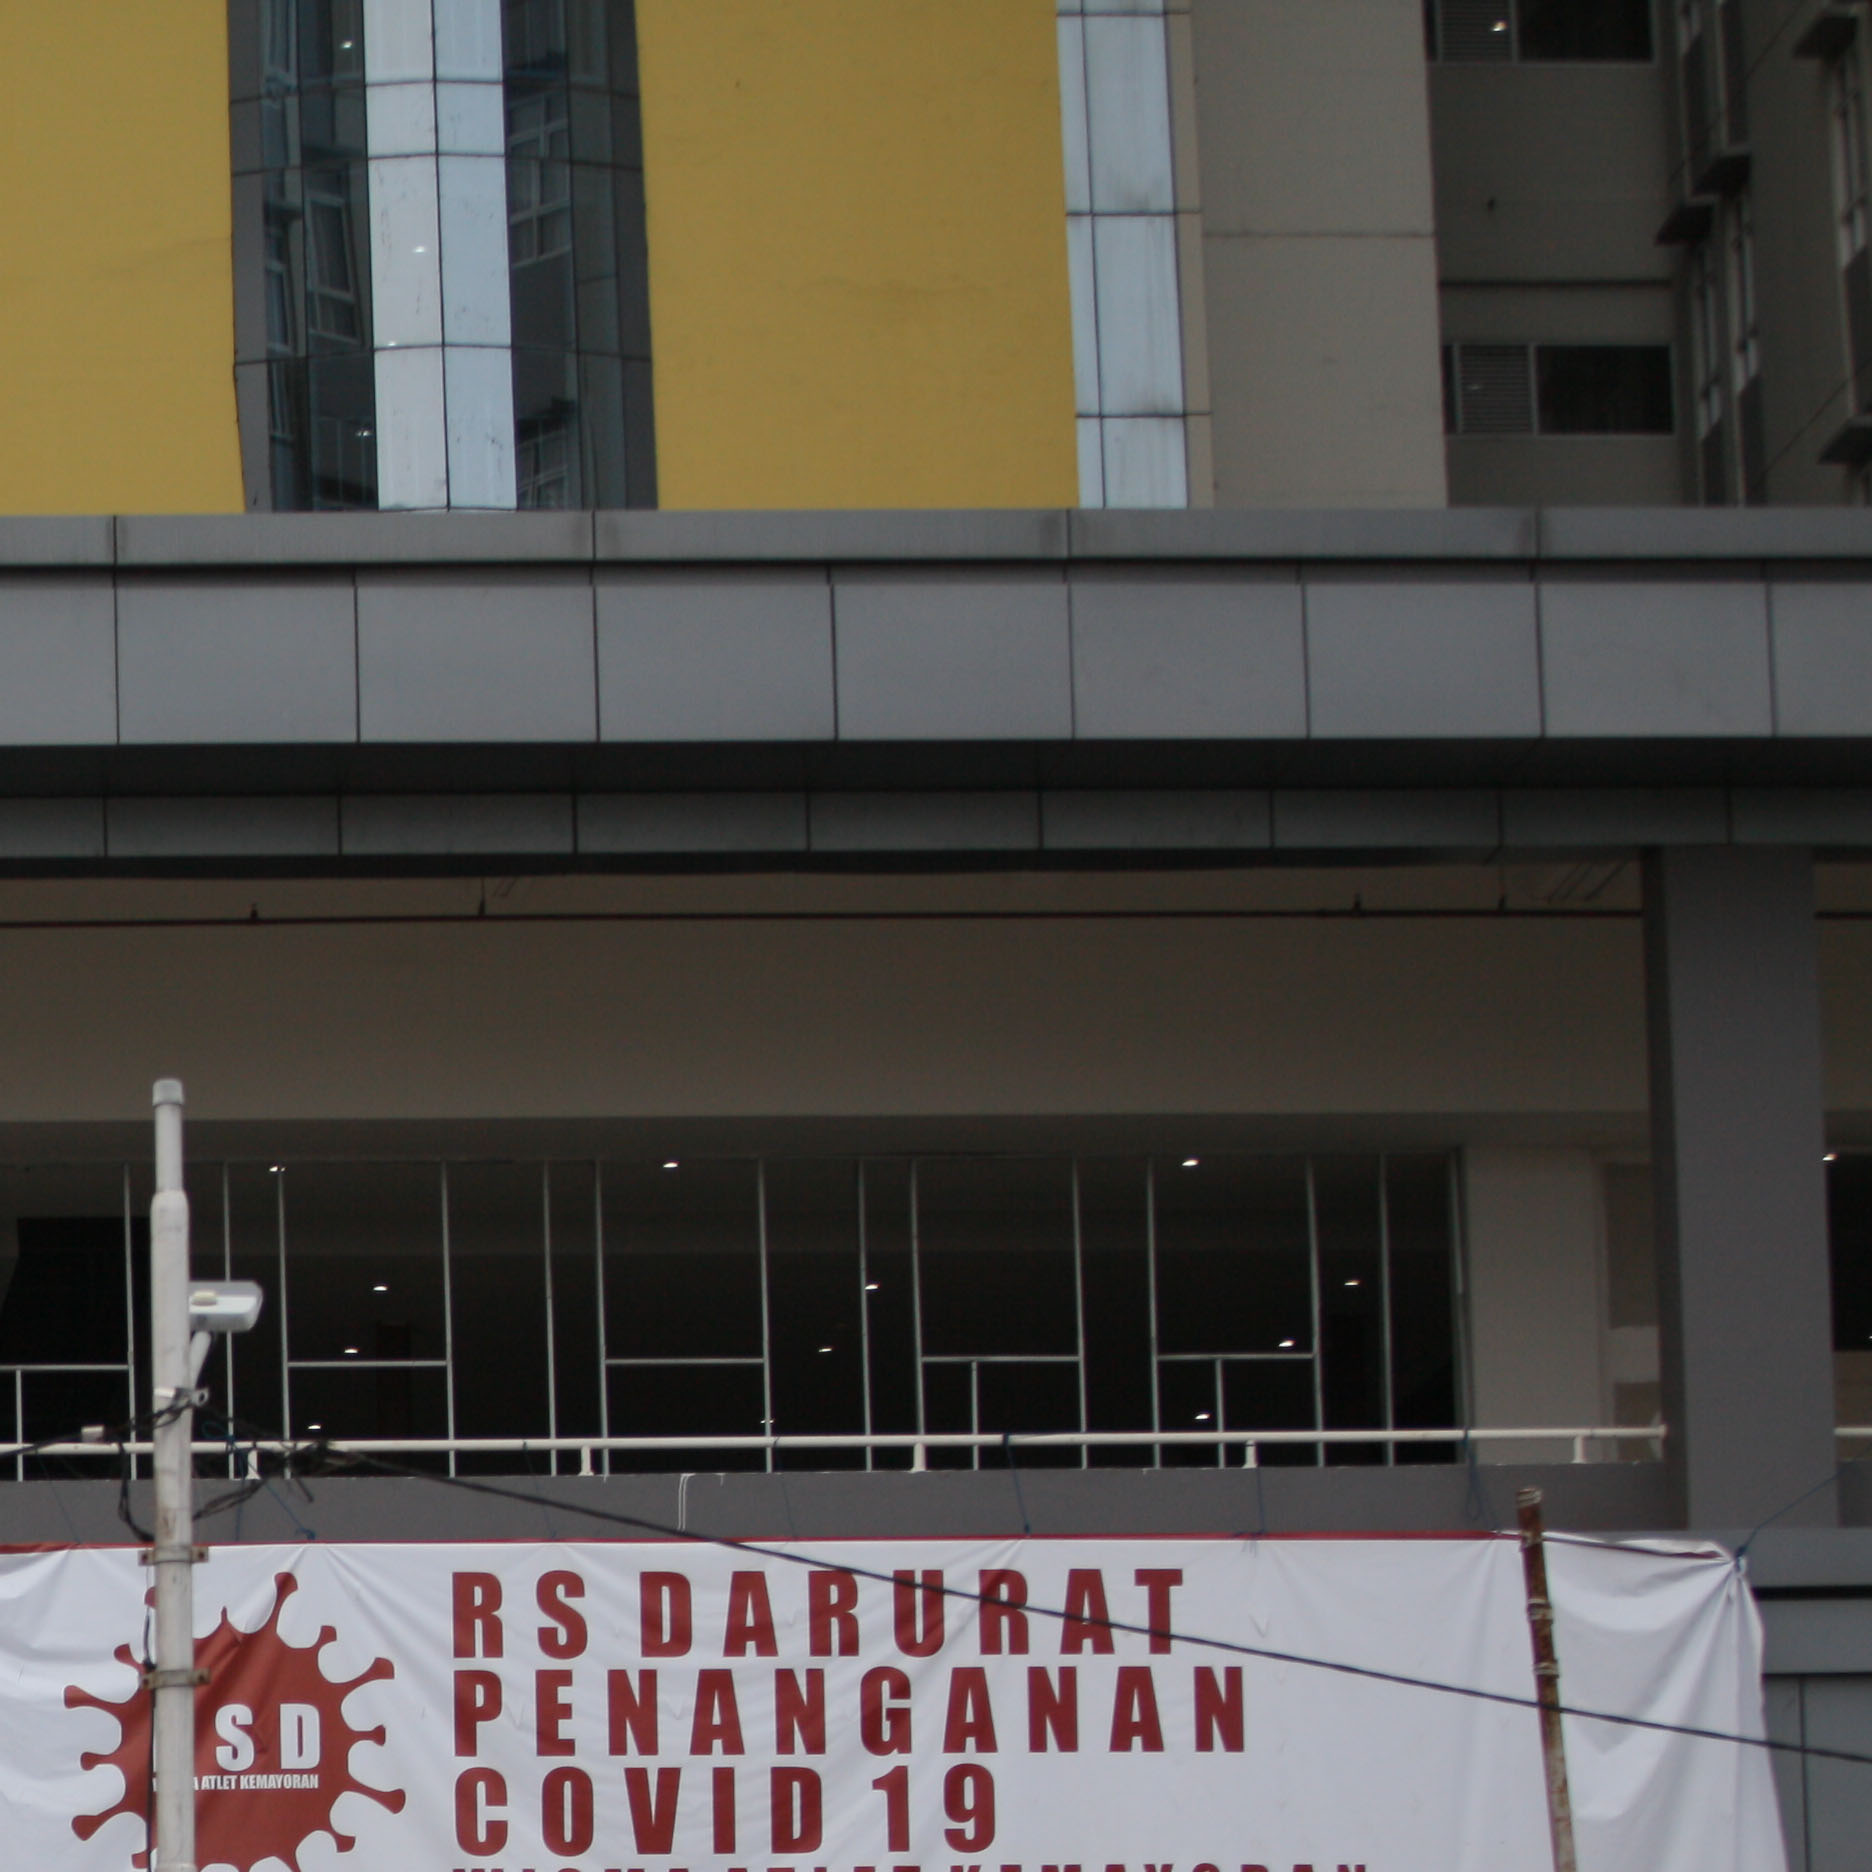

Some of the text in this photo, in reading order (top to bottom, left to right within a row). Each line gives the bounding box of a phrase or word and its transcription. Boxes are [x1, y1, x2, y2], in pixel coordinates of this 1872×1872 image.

[452, 1568, 1183, 1660] RS DARURAT
[453, 1665, 1244, 1758] PENANGANAN
[201, 1775, 238, 1790] ATLET
[239, 1773, 319, 1790] KEMAYORAN
[455, 1763, 995, 1858] COVID 19
